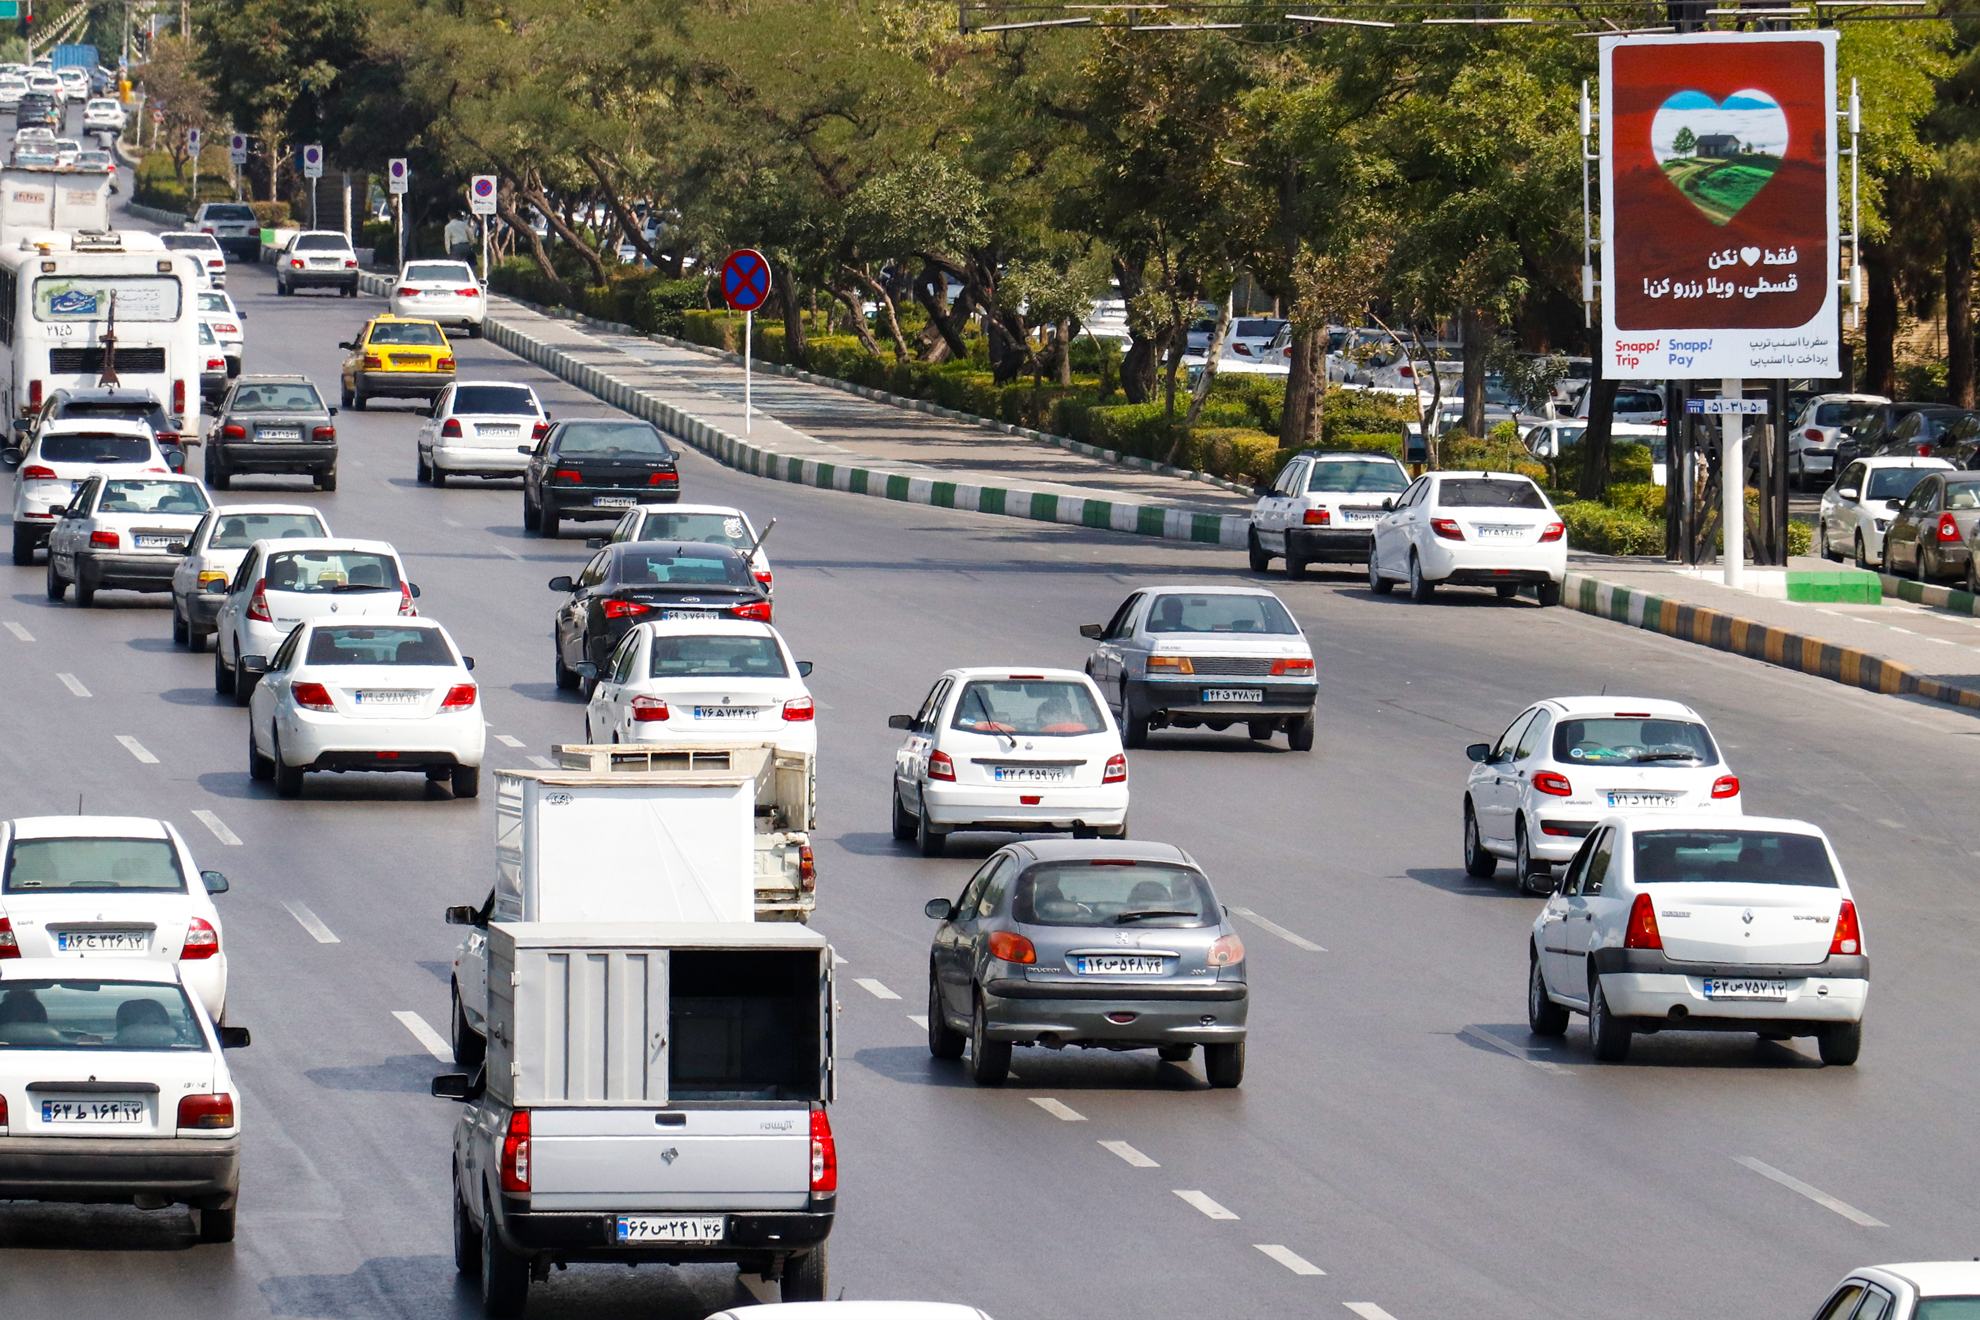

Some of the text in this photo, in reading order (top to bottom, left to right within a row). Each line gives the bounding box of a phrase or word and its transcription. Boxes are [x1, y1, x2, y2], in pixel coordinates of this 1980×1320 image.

[1708, 246, 1798, 270] فقط نکن
[1673, 279, 1703, 299] رزرو
[1706, 277, 1735, 299] ویلا
[1615, 339, 1661, 353] Snapp!
[1668, 339, 1713, 352] Snapp!
[1810, 336, 1829, 348] سفر
[1615, 353, 1640, 369] Trip
[1668, 353, 1694, 368] Pay
[1796, 354, 1829, 366] پرداخت
